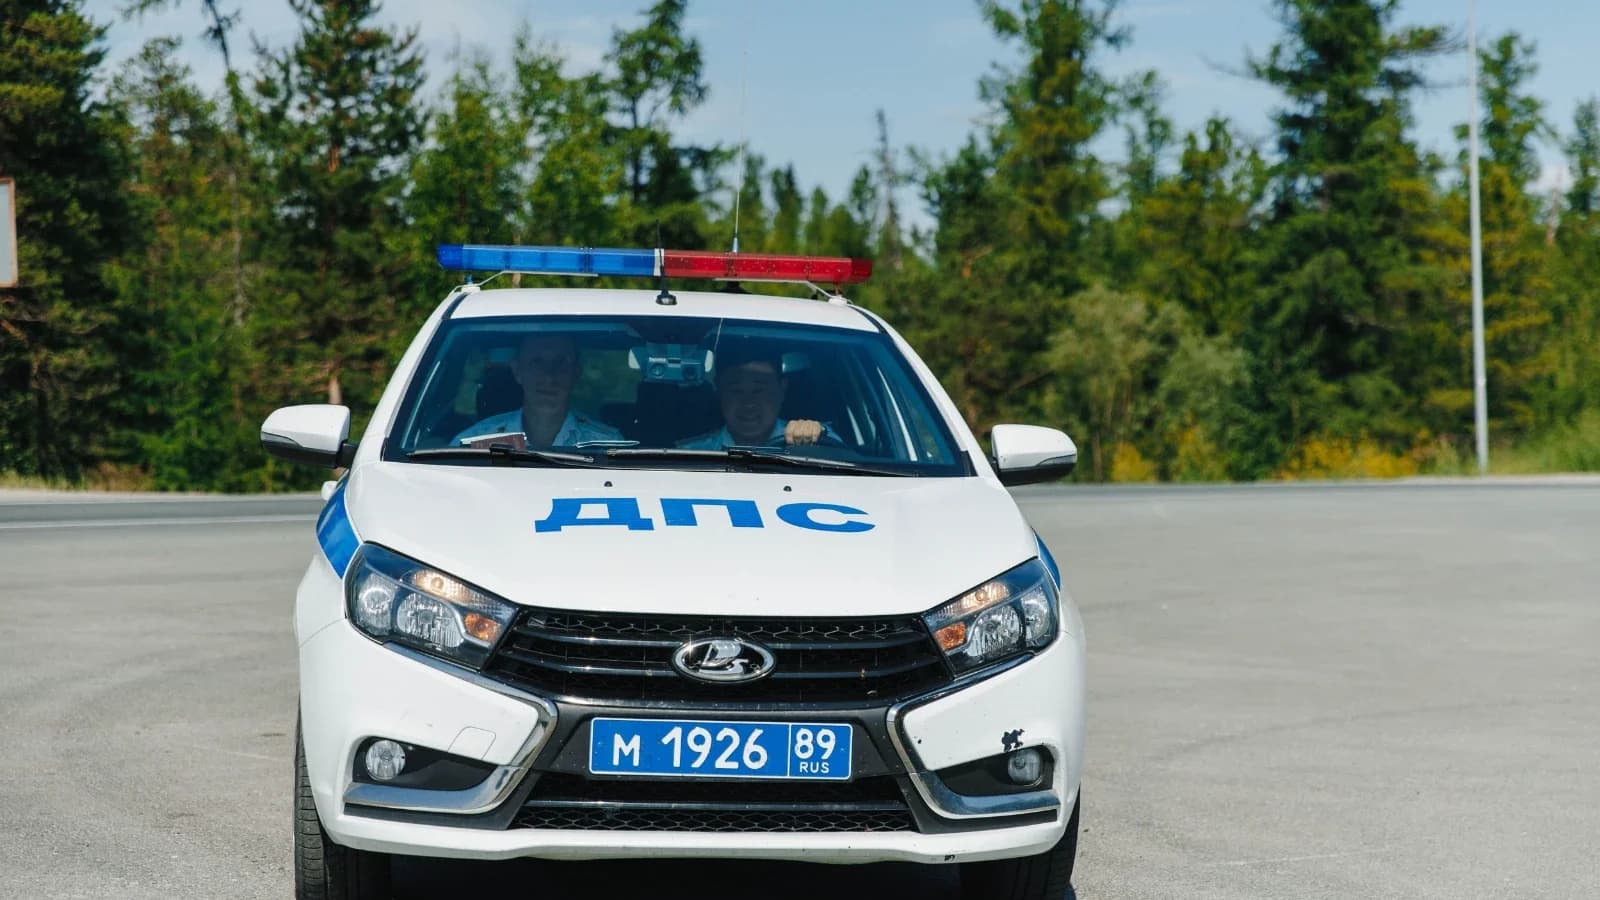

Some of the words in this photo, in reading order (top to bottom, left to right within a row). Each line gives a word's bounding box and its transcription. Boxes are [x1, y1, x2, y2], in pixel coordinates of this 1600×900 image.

[535, 497, 875, 533] ДПС
[661, 726, 768, 770] 1926
[794, 728, 836, 760] 89
[799, 761, 829, 773] RUS
